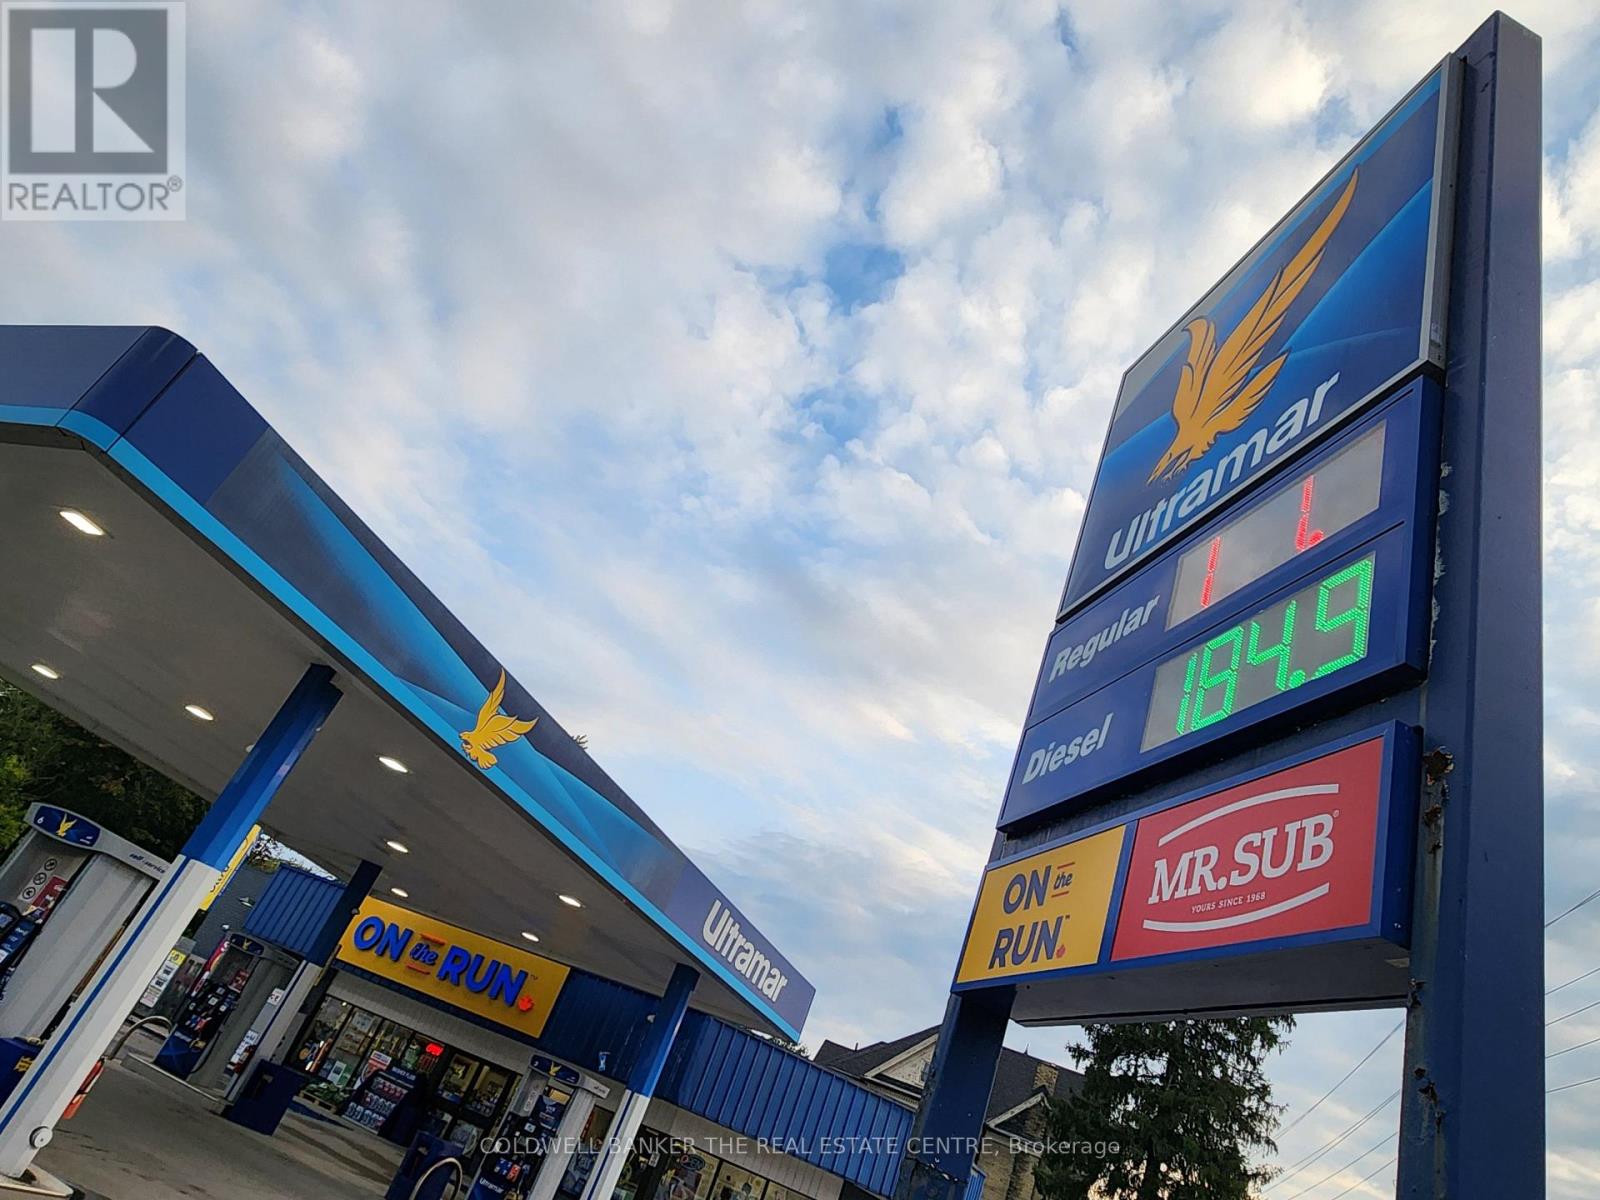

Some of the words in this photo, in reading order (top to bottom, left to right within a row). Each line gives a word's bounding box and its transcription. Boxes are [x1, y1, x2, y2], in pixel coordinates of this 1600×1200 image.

[1104, 371, 1341, 570] Ultramar
[1048, 595, 1161, 683] Regular
[1176, 559, 1373, 735] 184.9
[1021, 713, 1114, 785] Diesel
[1003, 865, 1052, 914] ON
[1053, 872, 1073, 891] the
[1191, 902, 1216, 914] YOURS
[1218, 896, 1243, 909] SINCE
[1247, 891, 1266, 903] 1968
[353, 915, 414, 963] ON
[409, 942, 439, 966] the
[436, 944, 529, 1008] RUN
[702, 899, 788, 1003] Ultramar
[988, 915, 1064, 970] RUN
